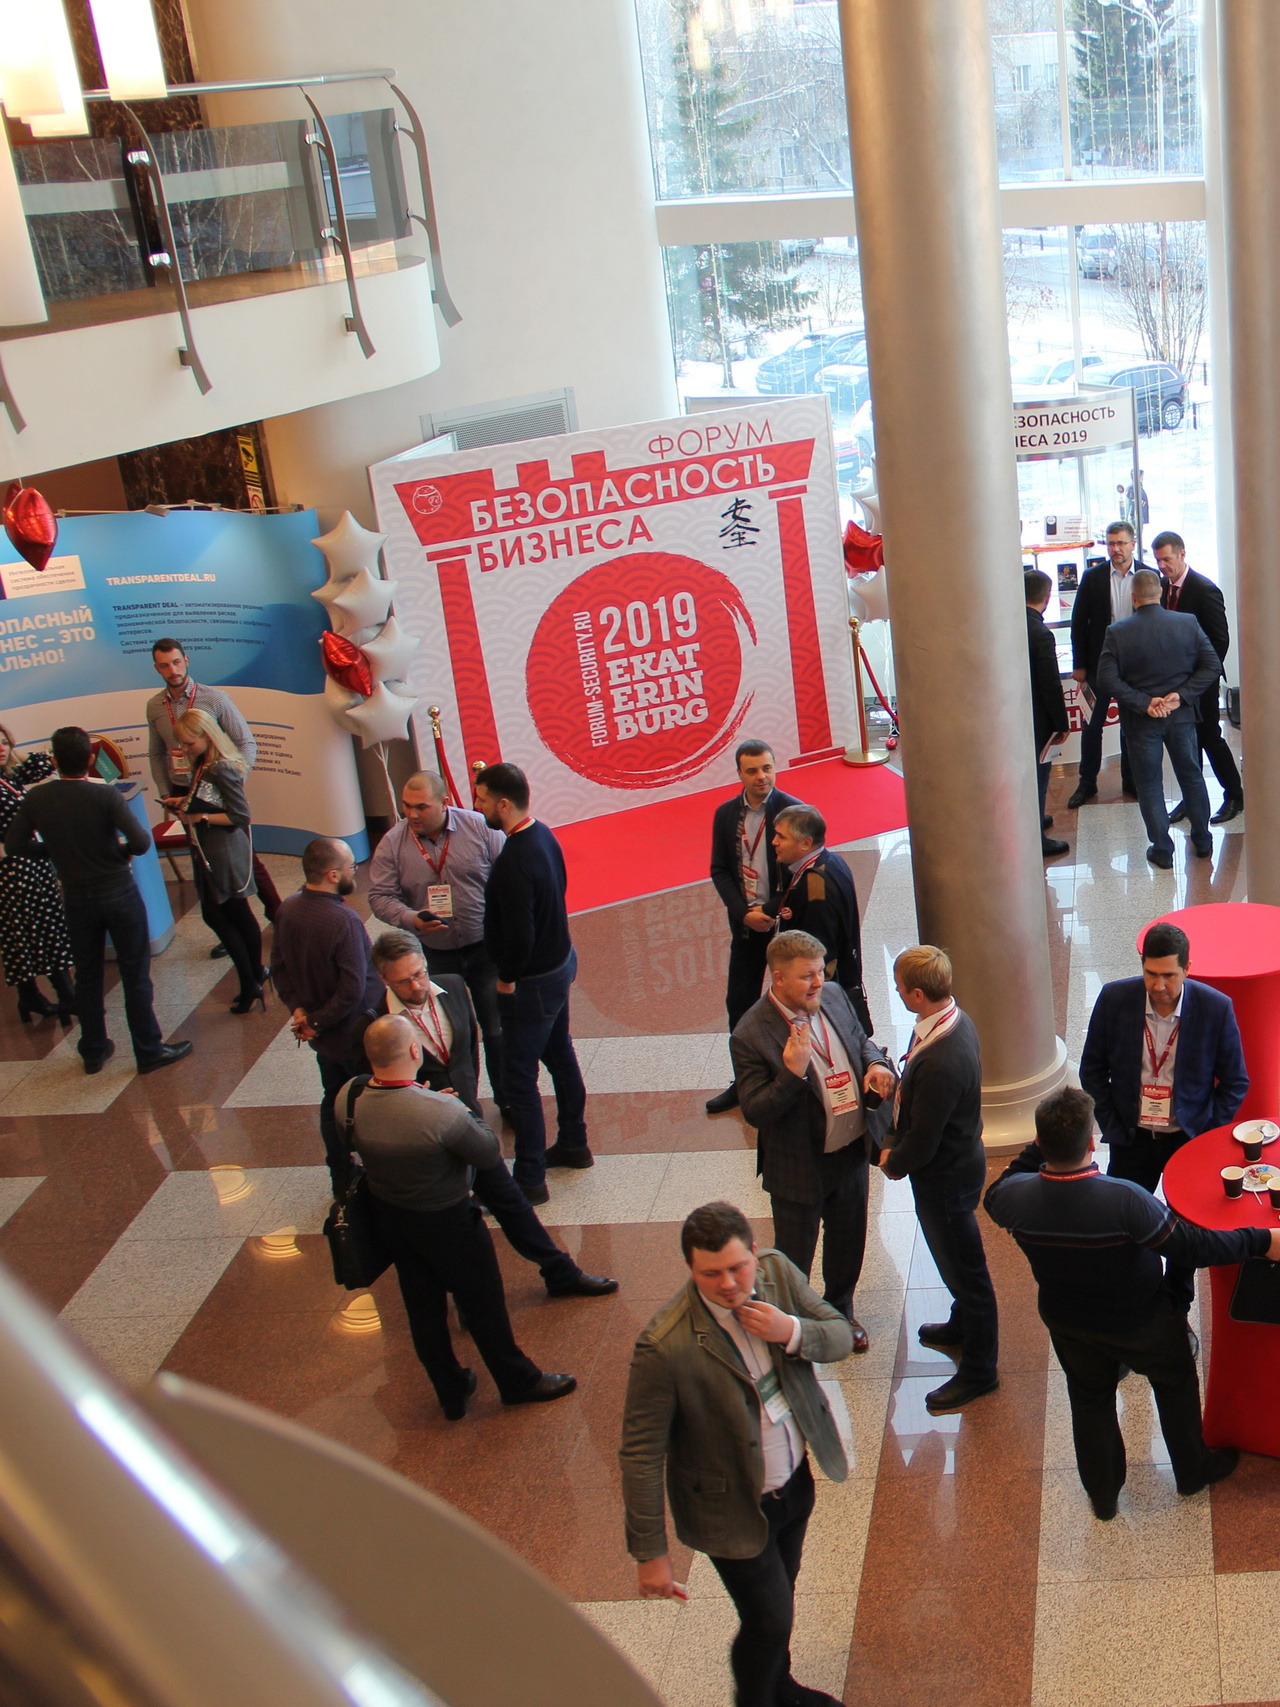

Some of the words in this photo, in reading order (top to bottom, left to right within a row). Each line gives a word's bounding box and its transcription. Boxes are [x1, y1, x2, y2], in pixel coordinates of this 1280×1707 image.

[648, 419, 773, 460] ФОРУМ
[1053, 430, 1088, 445] 2019
[470, 454, 776, 532] БЕЗОПАСНОСТЬ
[477, 515, 653, 573] БИЗНЕСА
[718, 497, 762, 550] 安全
[105, 573, 216, 586] TRANSPARENTDEAL.RU
[112, 602, 161, 611] TRANSPARENT
[599, 591, 699, 654] 2019
[0, 634, 39, 654] НЕС
[58, 626, 96, 644] ЭТО
[120, 639, 148, 647] Система
[573, 610, 609, 748] FORUM-SECURITY.RU
[607, 642, 700, 687] EKAT
[610, 670, 704, 714] ERIN
[615, 698, 709, 741] BURG
